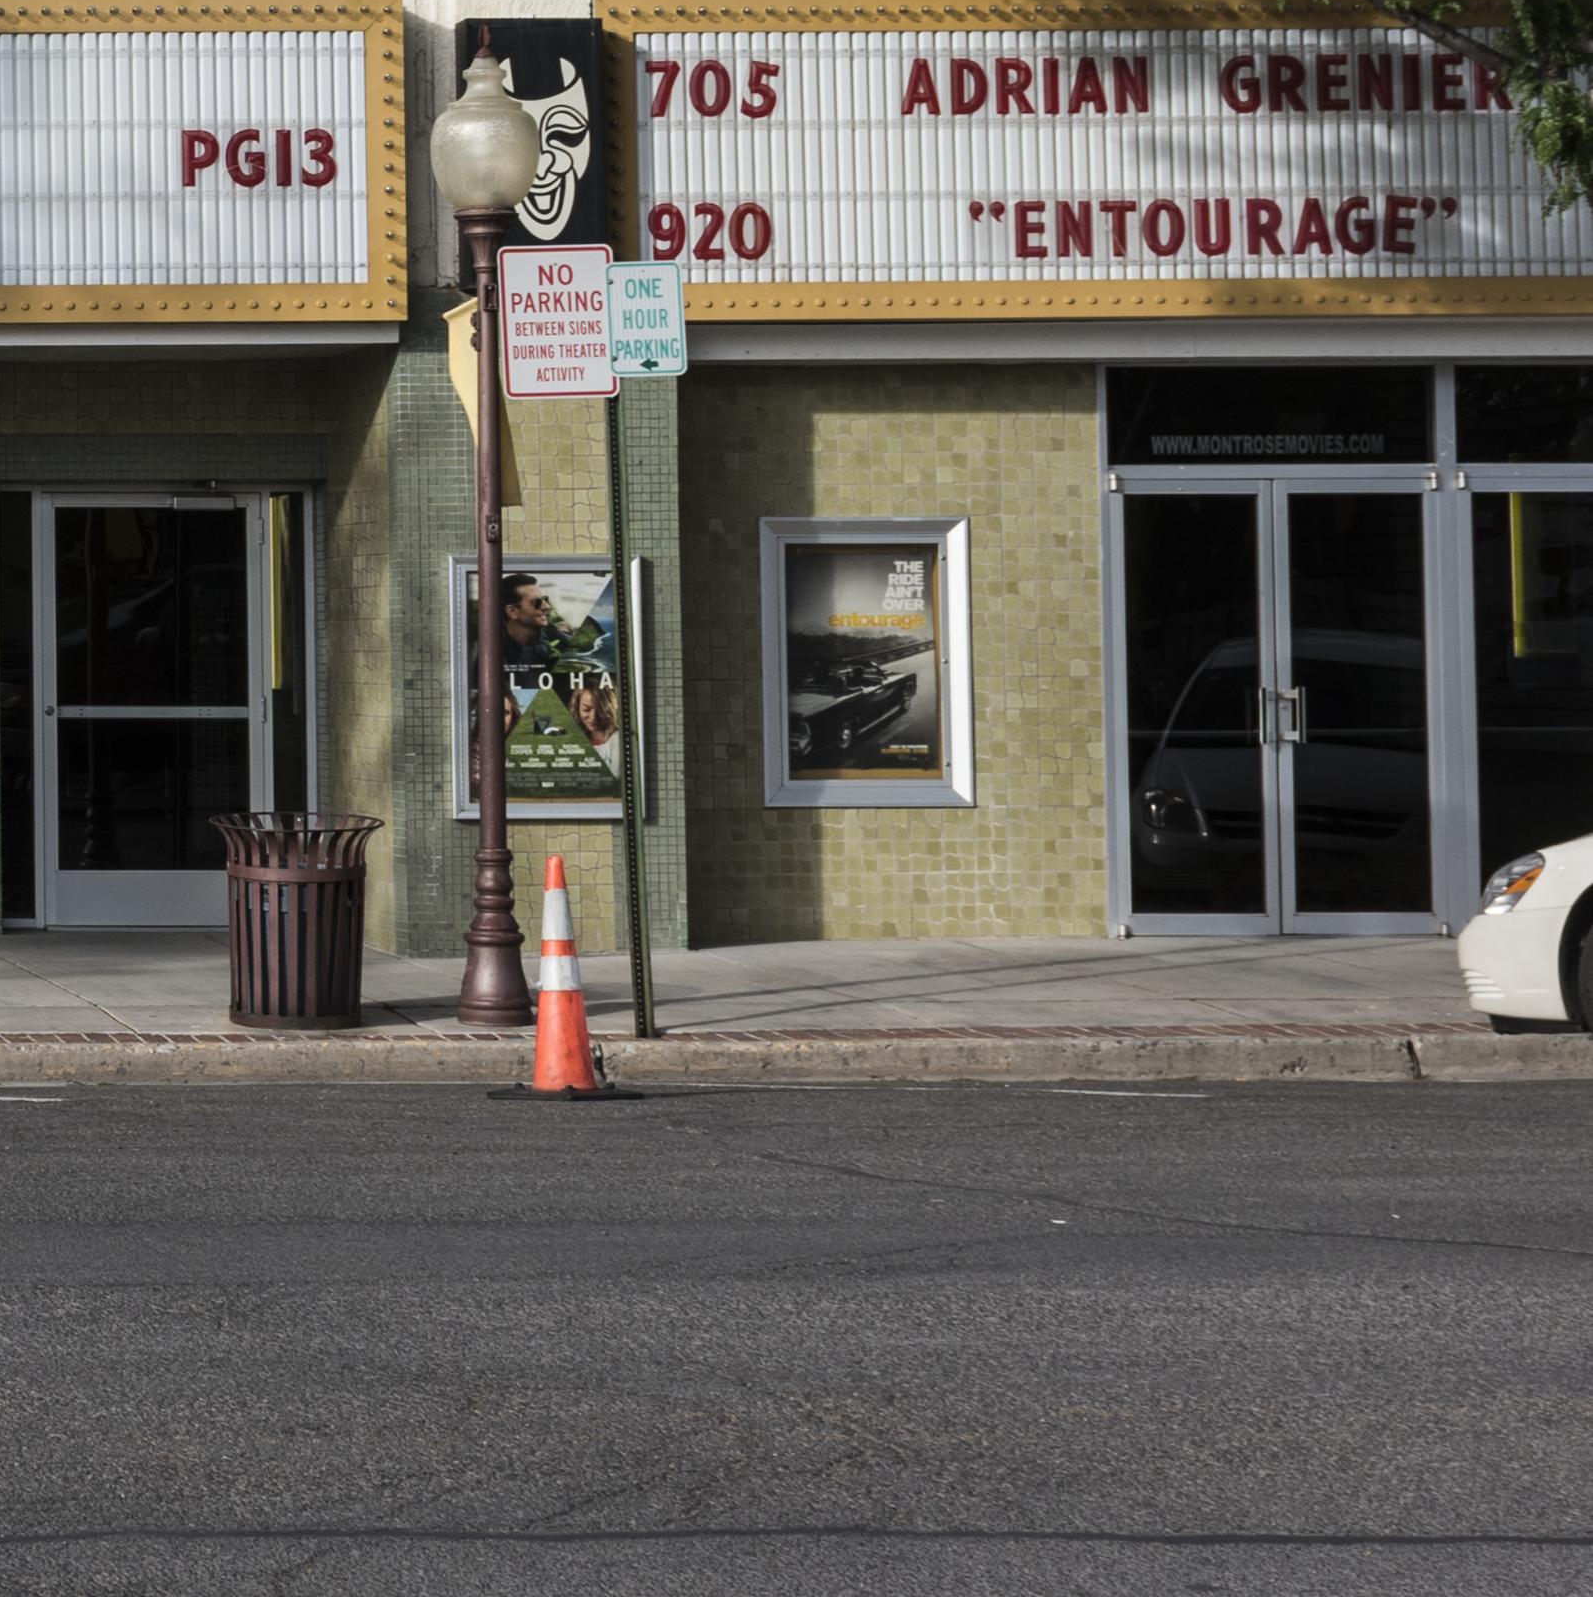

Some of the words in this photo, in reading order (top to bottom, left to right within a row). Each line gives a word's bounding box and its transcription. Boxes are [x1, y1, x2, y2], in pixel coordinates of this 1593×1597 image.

[645, 59, 781, 120] 705
[900, 56, 1150, 117] ADRIAN
[1221, 52, 1514, 116] GRENIER
[181, 127, 338, 189] PG13
[649, 202, 773, 262] 920
[968, 195, 1458, 260] "ENTOURAGE"
[538, 263, 574, 286] NO
[624, 278, 663, 299] ONE
[511, 290, 604, 314] PARKING
[515, 321, 565, 337] BETWEEN
[569, 320, 602, 335] SIGNS
[623, 309, 669, 330] HOUR
[513, 345, 555, 360] DURING
[559, 344, 607, 358] THEATER
[615, 338, 680, 360] PARKING
[536, 367, 586, 382] ACTIVITY
[1150, 434, 1385, 455] WWW.MONTROSEMOVIES.COM
[893, 560, 925, 573] THE
[887, 573, 925, 586] RIDE
[884, 586, 925, 598] AIN'T
[882, 599, 925, 612] OVER
[828, 612, 926, 630] entourage
[509, 672, 614, 690] LOHA
